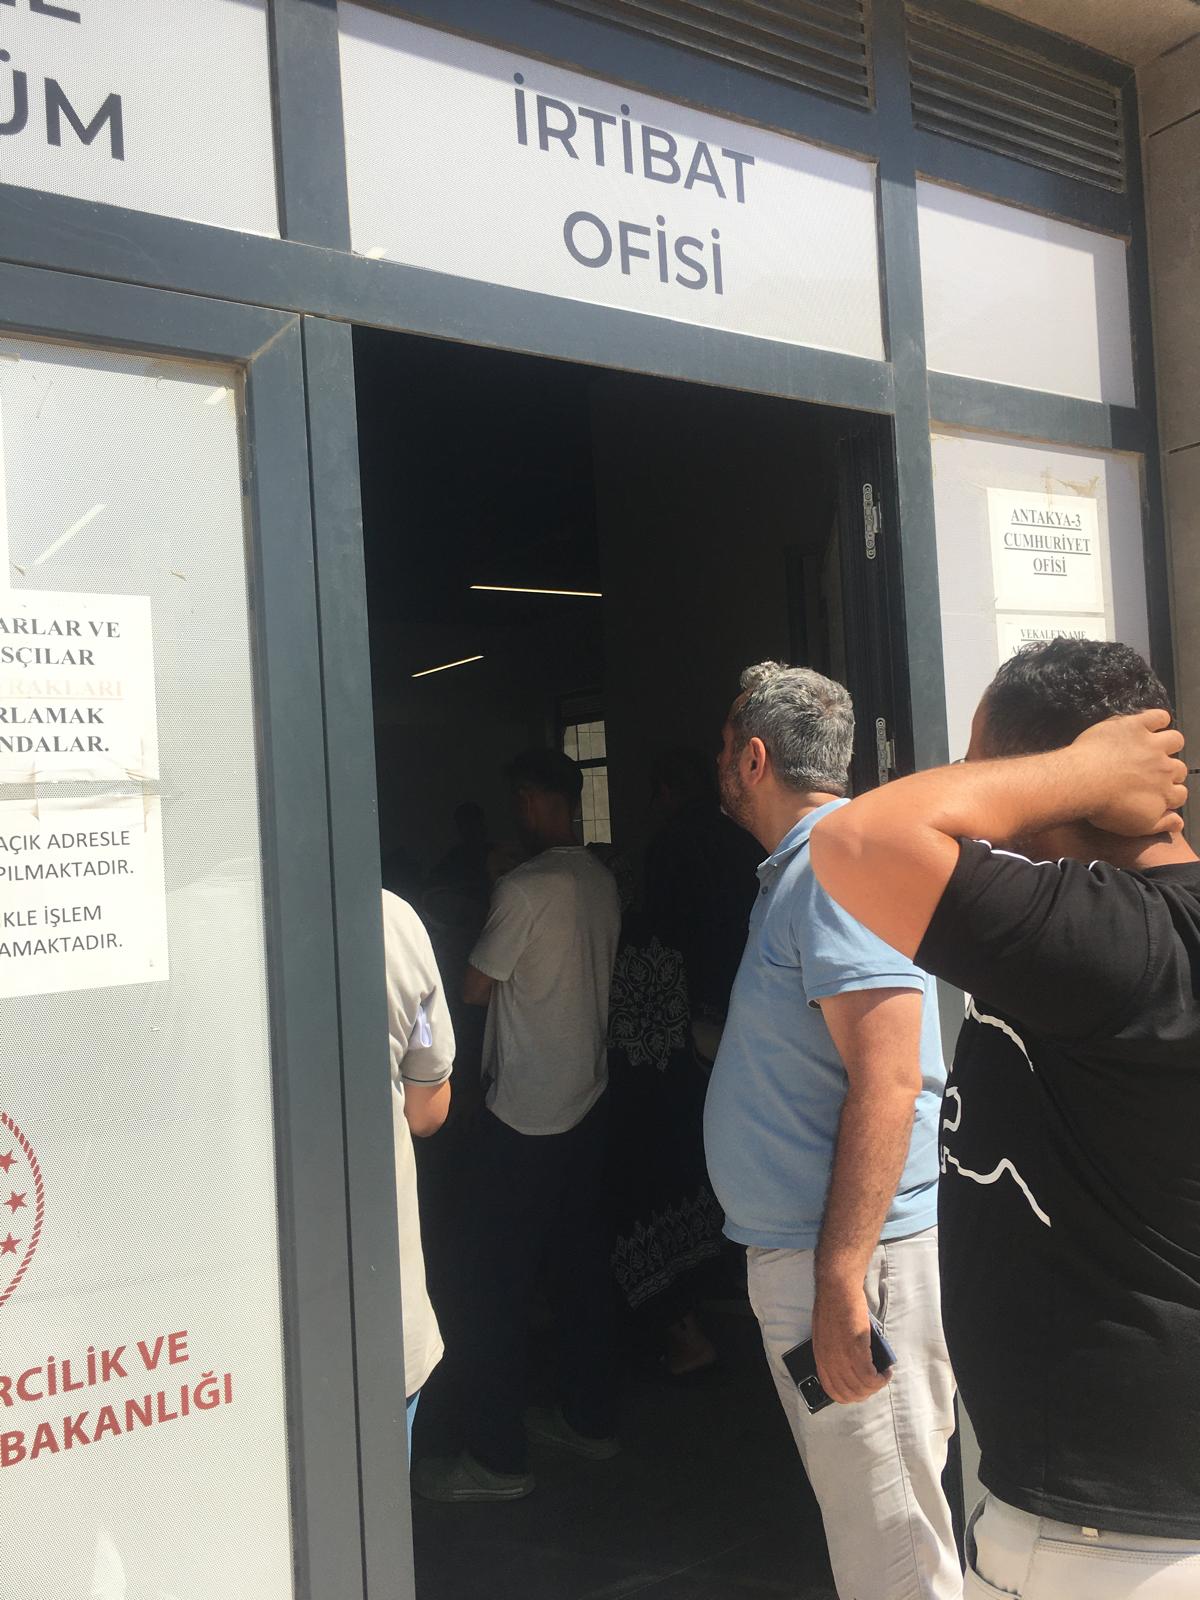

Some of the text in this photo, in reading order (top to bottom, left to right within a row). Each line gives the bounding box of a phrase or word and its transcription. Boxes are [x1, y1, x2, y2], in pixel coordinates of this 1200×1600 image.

[513, 72, 755, 204] İRTİBAT
[563, 211, 724, 295] OFİSİ
[1011, 508, 1082, 528] ANTAKYA-3
[1003, 531, 1091, 552] CUMHURİYET
[1033, 555, 1067, 574] OFİSİ
[88, 621, 121, 638] VE
[1, 646, 96, 668] SÇILAR
[0, 735, 109, 753] NDALAR.
[47, 830, 131, 849] ADRESLE
[3, 905, 102, 928] KLE İŞLEM
[0, 933, 123, 958] AMAKTADIR.
[136, 1330, 190, 1371] VE
[0, 1370, 233, 1468] BAKANLIĞI
